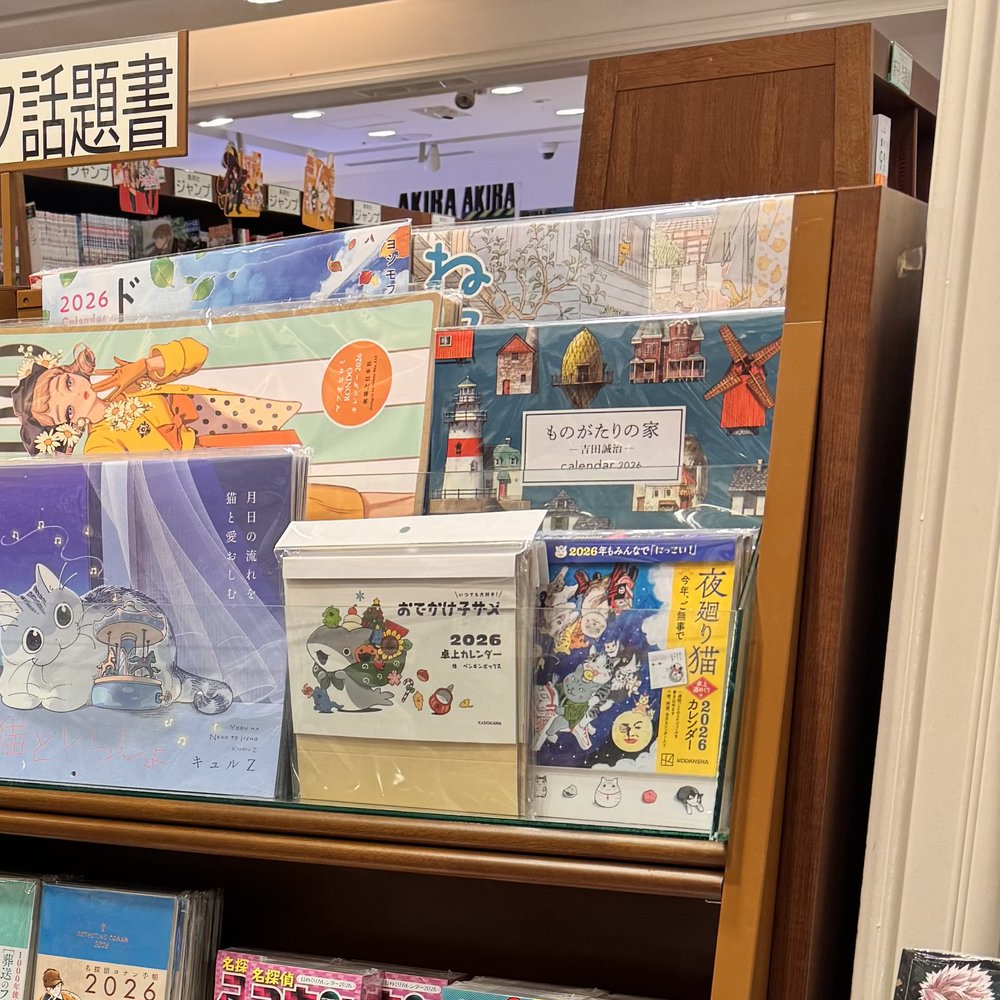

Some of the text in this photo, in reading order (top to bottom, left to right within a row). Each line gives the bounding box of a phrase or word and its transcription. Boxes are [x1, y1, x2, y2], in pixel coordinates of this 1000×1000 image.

[176, 179, 210, 198] ジャンプ
[270, 193, 299, 210] ジャンプ
[399, 182, 516, 220] AKIRA AKIRA
[60, 291, 109, 314] 2026
[344, 367, 353, 402] RONDO
[546, 420, 660, 441] ものがたりの家
[560, 459, 643, 471] calendar 2026
[225, 490, 238, 600] 猫と愛おしむ
[245, 490, 257, 600] 月日の流れを
[397, 600, 501, 617] おでかけ子サメ
[675, 574, 692, 641] 今年、ご無事で
[688, 567, 728, 676] 夜廻り猫
[450, 634, 502, 646] 2026
[440, 649, 503, 660] 卓上カレンダー
[684, 699, 699, 751] カレンダー
[698, 701, 711, 751] 2026
[677, 757, 710, 765] KODANSHA
[84, 963, 160, 981] 名探偵コナン手帳
[251, 967, 295, 987] 名探偵
